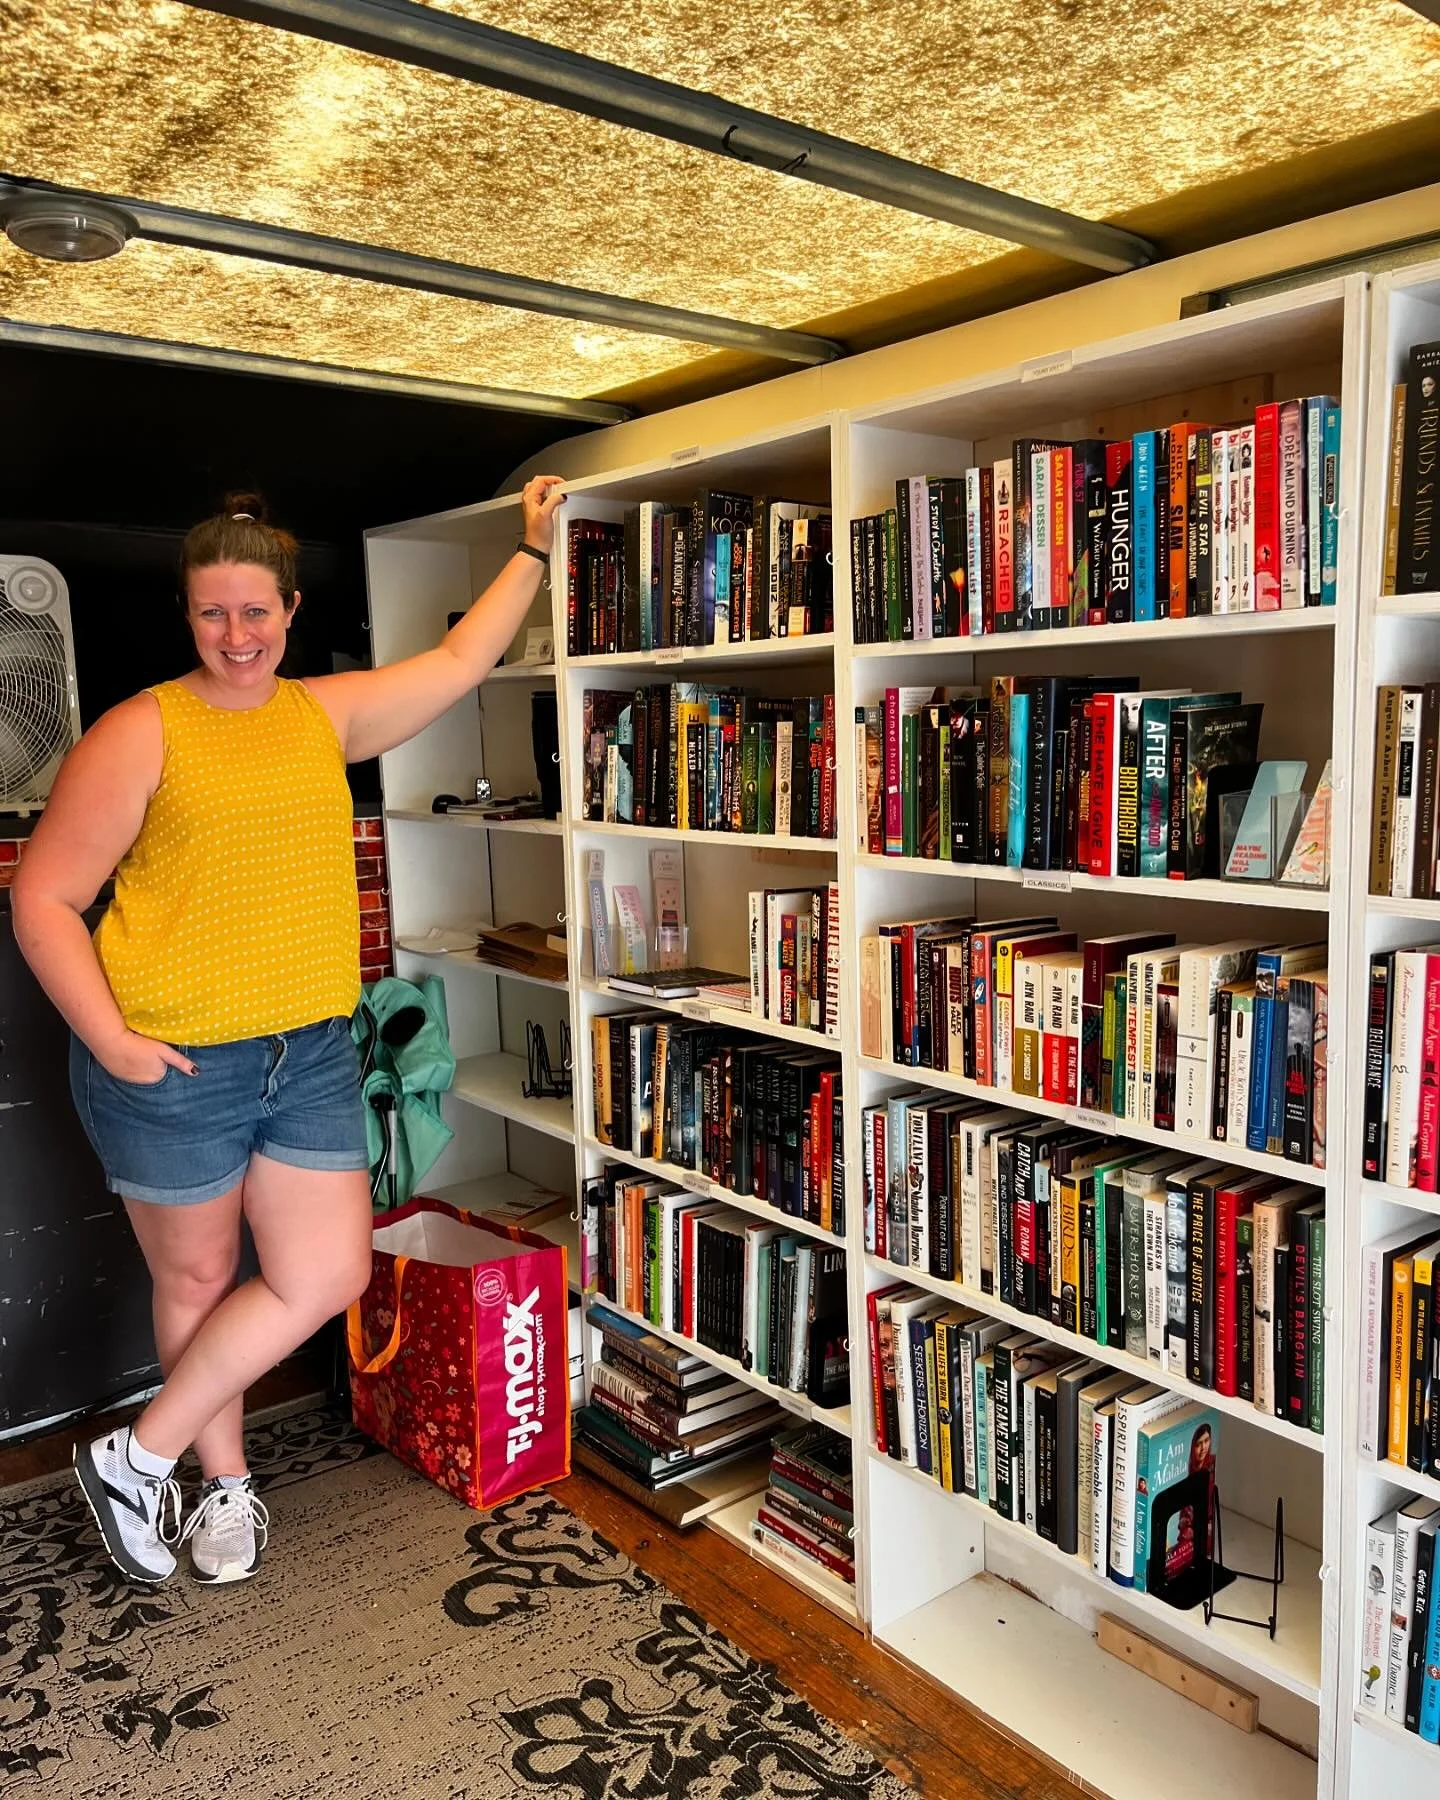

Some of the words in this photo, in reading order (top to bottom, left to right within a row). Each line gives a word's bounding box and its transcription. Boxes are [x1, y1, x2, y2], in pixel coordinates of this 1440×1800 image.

[1036, 457, 1045, 499] SARAH
[1055, 454, 1064, 497] SARAH
[1284, 435, 1296, 508] DREAMLAND
[1200, 490, 1208, 517] EVIL
[1036, 504, 1045, 547] DESSEN
[1055, 501, 1064, 545] DESSEN
[1171, 505, 1183, 550] SLAM
[1284, 512, 1296, 564] BURNING
[674, 541, 683, 562] DEAN
[1111, 489, 1129, 591] HUNGER
[1200, 523, 1208, 555] STAR
[999, 509, 1009, 605] REACHED
[671, 564, 682, 595] KOONTZ
[1092, 714, 1105, 743] THE
[1385, 691, 1395, 740] Angela's
[1032, 721, 1045, 769] CARVE
[1146, 720, 1166, 778] AFTER
[1092, 749, 1105, 790] HATE
[1171, 758, 1181, 772] END
[1383, 744, 1392, 778] Ashes
[1425, 749, 1433, 775] CASTE
[1092, 795, 1105, 806] U
[1118, 767, 1137, 846] BIRTHRIGHT
[1171, 798, 1181, 827] WORLD
[1381, 786, 1389, 816] Frank
[1422, 798, 1431, 833] OUTCAST
[1032, 802, 1045, 845] MARK
[1092, 810, 1105, 848] GIVE
[1171, 830, 1181, 850] CLUB
[1379, 821, 1388, 864] McCourt
[1027, 879, 1066, 890] CLASSICS
[828, 888, 839, 947] MICHAEL
[783, 975, 791, 1021] COALESCENT
[949, 966, 961, 1004] ROOTS
[1024, 981, 1034, 998] AYN
[1051, 986, 1062, 1002] AYN
[1428, 978, 1439, 1011] Angels
[1024, 1001, 1034, 1023] RAND
[1051, 1005, 1062, 1028] RAND
[1430, 1012, 1439, 1030] and
[1127, 1011, 1137, 1069] TEMPEST
[1425, 1032, 1436, 1055] Ages
[1368, 1028, 1382, 1089] DELIVERANCE
[1423, 1091, 1434, 1120] Adam
[876, 1120, 884, 1135] RED
[912, 1114, 924, 1132] TOM
[876, 1138, 884, 1166] NOTICE
[912, 1135, 924, 1167] CLANCY
[1421, 1123, 1432, 1160] Gopnik
[1017, 1142, 1031, 1178] CATCH
[876, 1178, 884, 1194] BILL
[1014, 1175, 1025, 1198] AND
[1192, 1192, 1203, 1210] THE
[876, 1197, 884, 1235] BROWDER
[911, 1190, 924, 1224] Shadow
[939, 1195, 948, 1230] PORTRAIT
[1017, 1197, 1031, 1221] KILL
[1218, 1201, 1228, 1236] FLASH
[911, 1225, 924, 1262] Warriors
[939, 1231, 948, 1240] OF
[1020, 1225, 1030, 1259] RONAN
[1062, 1204, 1075, 1258] BIRDS
[1155, 1216, 1163, 1259] STRANGERS
[1192, 1215, 1203, 1243] PRICE
[939, 1247, 948, 1272] KILLER
[1155, 1262, 1163, 1270] IN
[1192, 1247, 1203, 1258] OF
[1218, 1240, 1228, 1266] BOYS
[1312, 1256, 1322, 1279] THE
[1015, 1254, 1023, 1294] FARROW
[1192, 1262, 1203, 1304] JUSTICE
[1294, 1244, 1305, 1303] DEVIL'S
[1368, 1261, 1376, 1285] HOPE
[1312, 1281, 1322, 1305] SLOT
[1368, 1288, 1376, 1296] IS
[1218, 1285, 1228, 1335] MICHAEL
[1312, 1307, 1322, 1344] SWING
[892, 1322, 902, 1351] Diana
[937, 1328, 945, 1352] THEIR
[1294, 1310, 1305, 1378] BARGAIN
[1367, 1308, 1375, 1354] WOMAN'S
[535, 1313, 547, 1384] tjmaxx.com
[1394, 1336, 1402, 1380] GENEROSITY
[913, 1344, 924, 1388] SEEKERS
[938, 1353, 946, 1377] LIFE'S
[1366, 1357, 1374, 1384] NAME
[537, 1386, 546, 1417] shop
[939, 1379, 947, 1401] WORK
[996, 1378, 1008, 1401] THE
[917, 1398, 928, 1449] HORIZON
[996, 1404, 1008, 1438] GAME
[1118, 1412, 1127, 1453] SPIRIT
[997, 1440, 1009, 1455] OF
[1093, 1422, 1103, 1498] Unbelievable
[1158, 1448, 1164, 1466] I
[1167, 1442, 1184, 1458] Am
[997, 1456, 1010, 1485] LIFE
[1115, 1456, 1125, 1493] LEVEL
[1153, 1463, 1188, 1489] Malala
[1136, 1507, 1146, 1523] Am
[1136, 1525, 1146, 1554] Malala
[1368, 1538, 1376, 1552] Tan
[1377, 1540, 1385, 1558] Amy
[1394, 1528, 1408, 1572] Kingdom
[1396, 1575, 1406, 1587] of
[1416, 1569, 1427, 1595] Gothic
[1394, 1589, 1405, 1609] Play
[1391, 1632, 1403, 1659] David
[1389, 1661, 1400, 1698] Toomey
